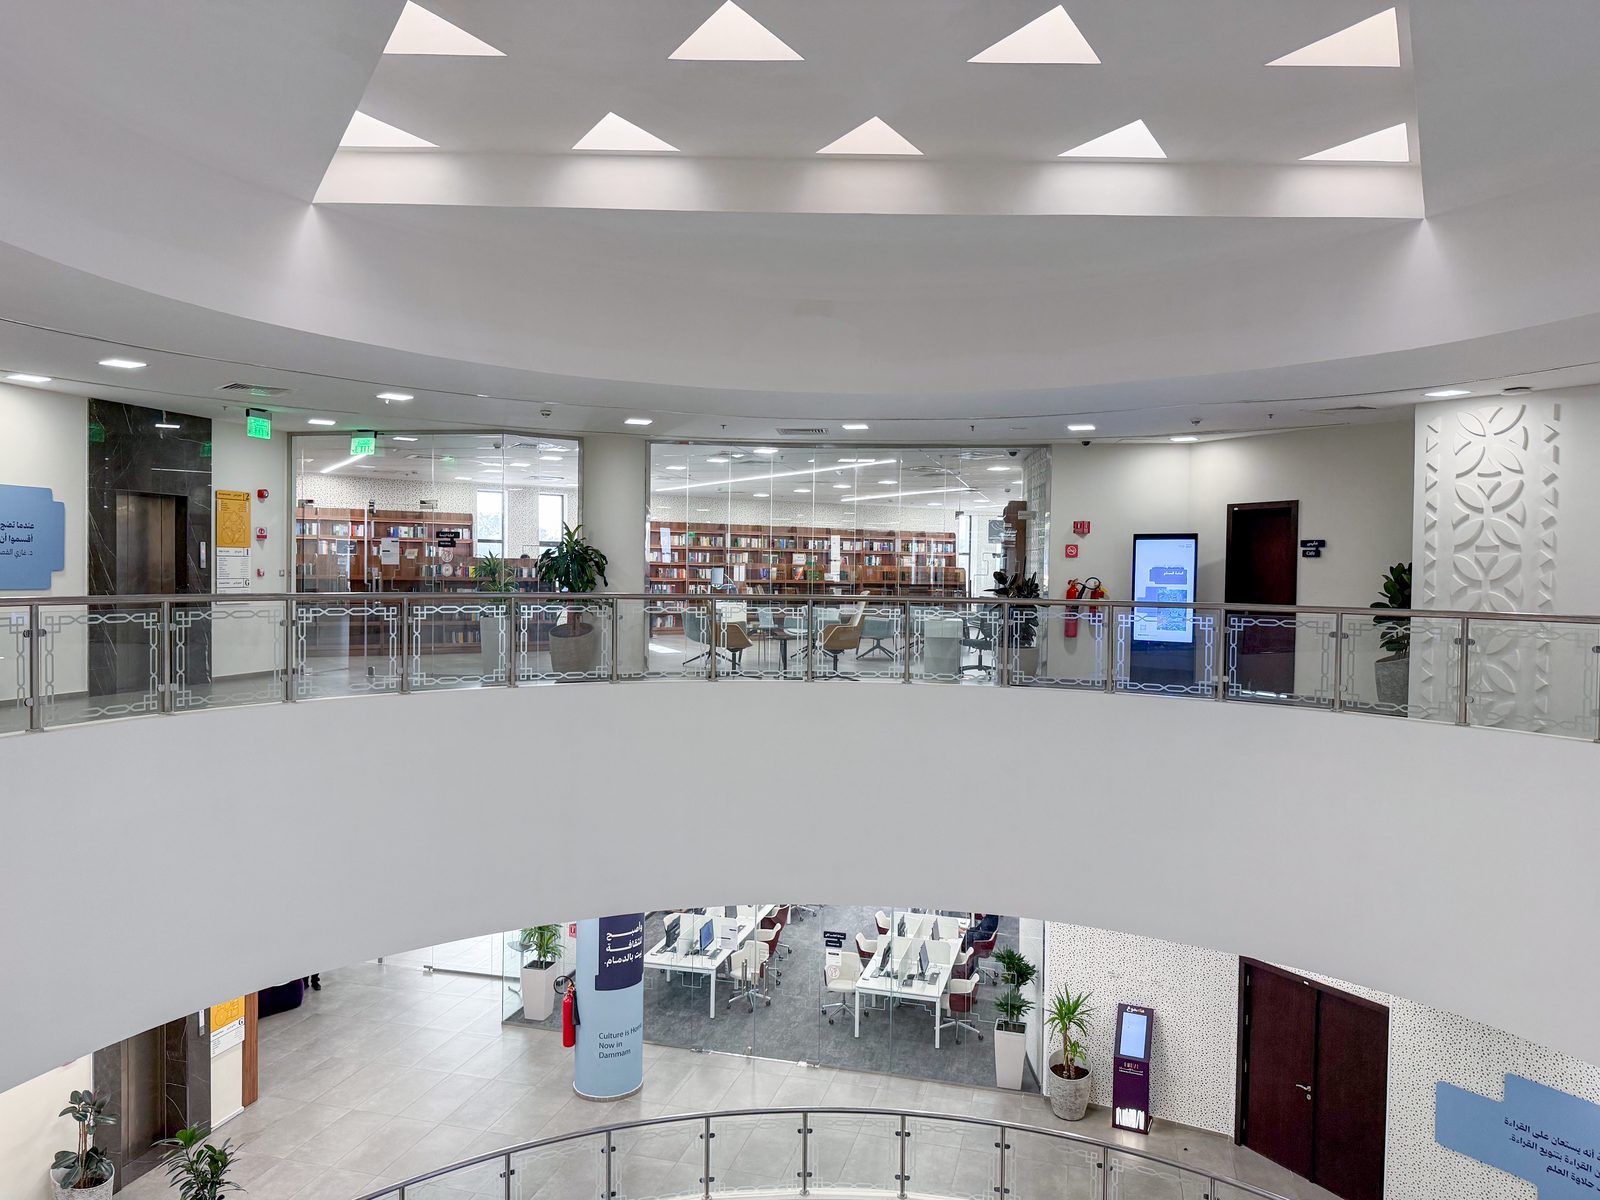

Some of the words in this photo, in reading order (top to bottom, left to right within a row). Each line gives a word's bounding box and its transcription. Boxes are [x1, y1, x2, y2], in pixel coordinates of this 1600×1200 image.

[17, 521, 34, 529] عندما
[9, 533, 33, 544] أقسموا
[244, 579, 250, 587] G
[598, 1031, 624, 1040] Culture
[625, 1028, 630, 1036] is
[598, 1048, 631, 1059] Dammam
[1504, 1116, 1531, 1133] القراءة
[1532, 1131, 1549, 1141] على
[1564, 1155, 1592, 1172] القراءة
[1546, 1164, 1569, 1177] العلم
[1570, 1172, 1595, 1188] حلاوة
